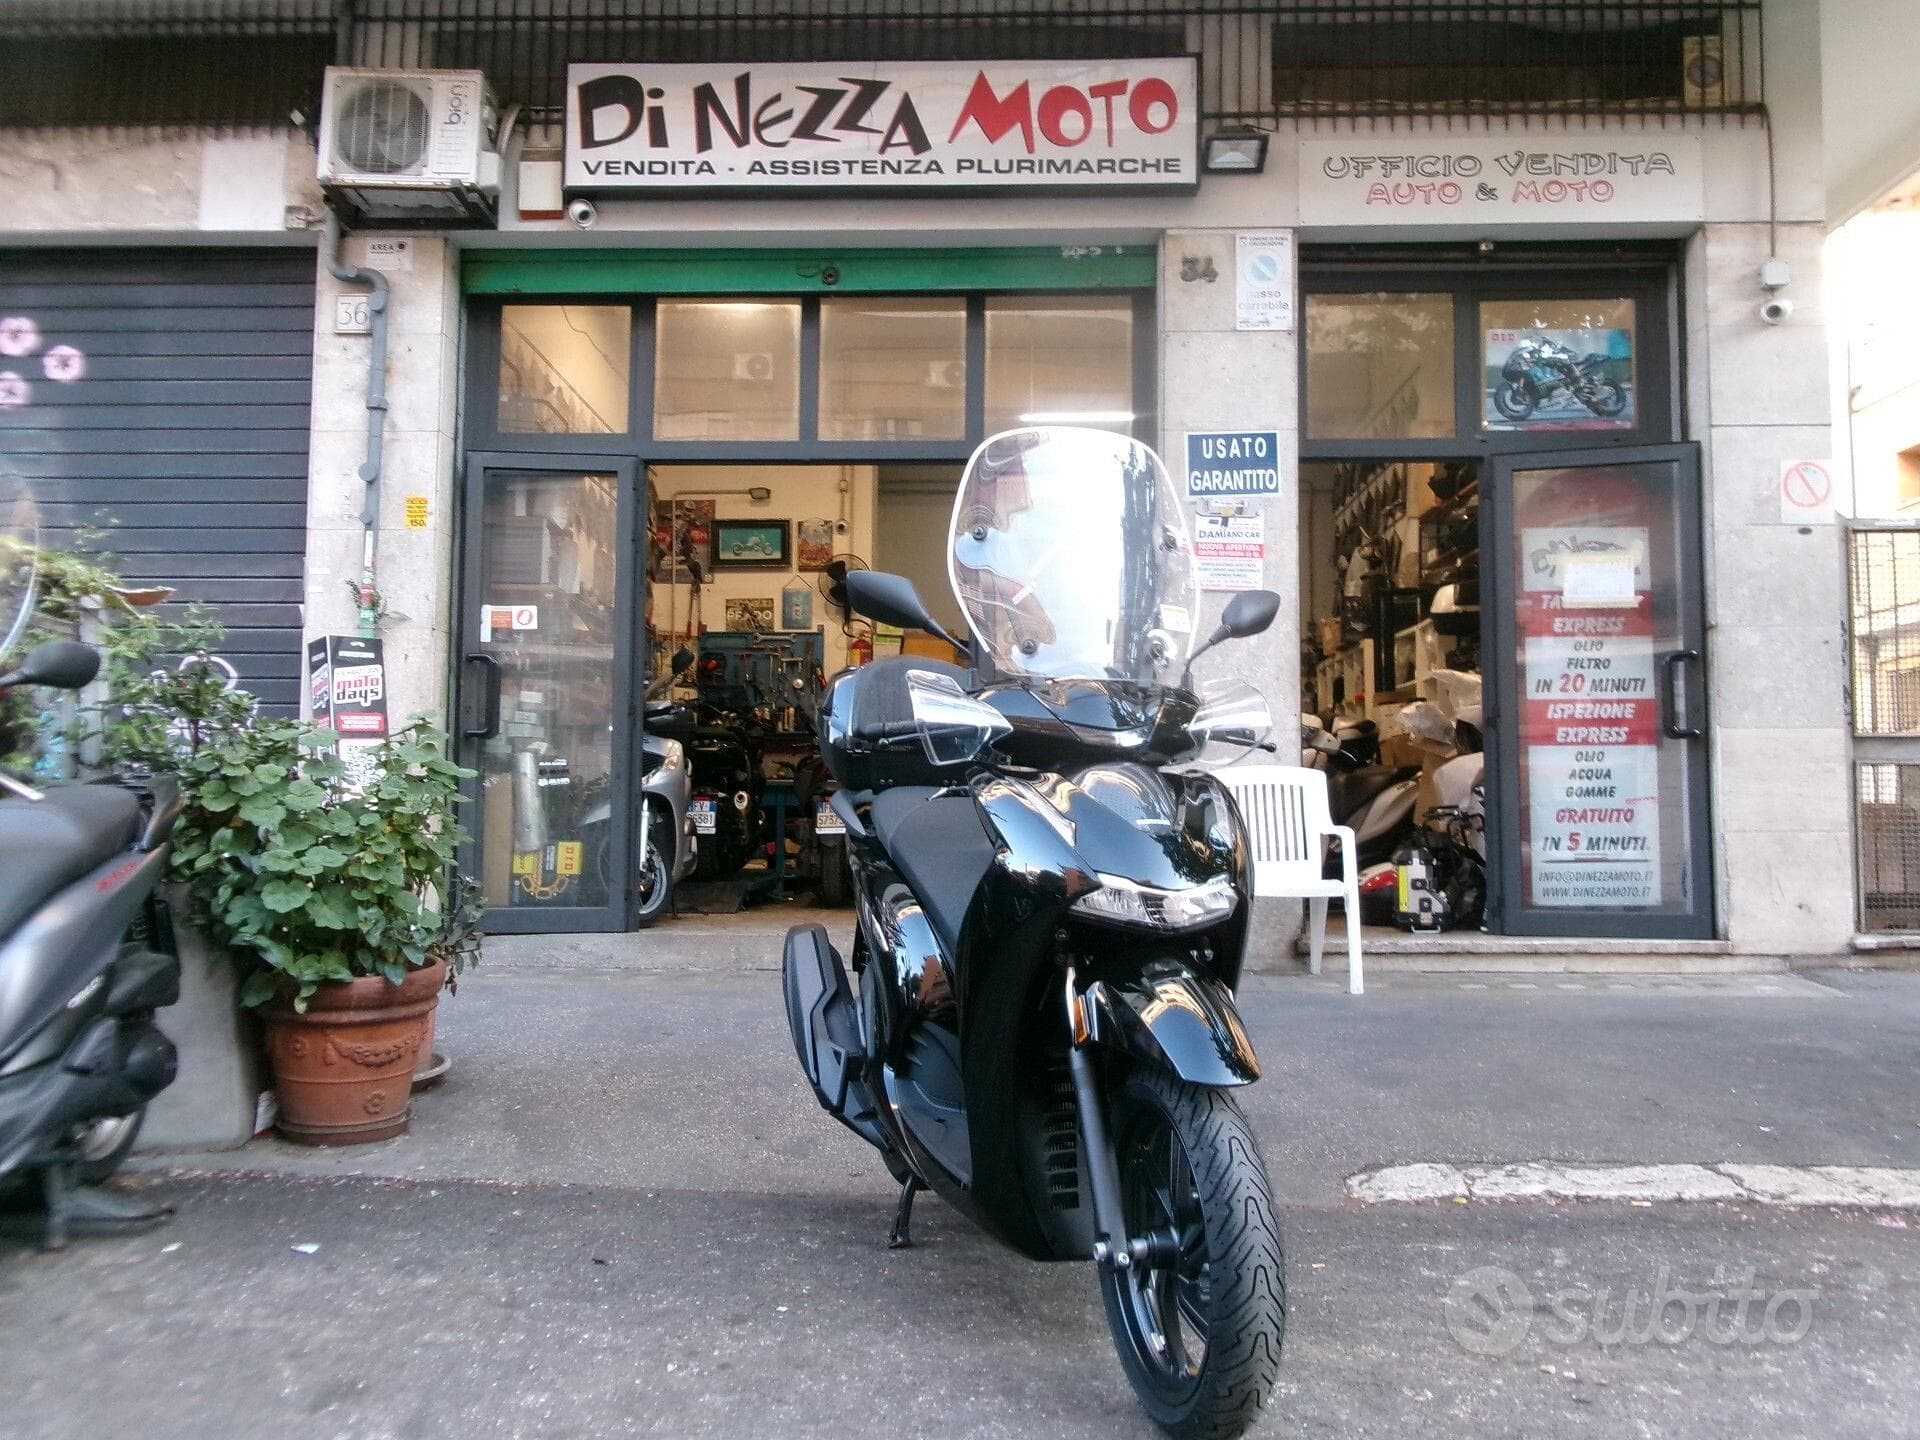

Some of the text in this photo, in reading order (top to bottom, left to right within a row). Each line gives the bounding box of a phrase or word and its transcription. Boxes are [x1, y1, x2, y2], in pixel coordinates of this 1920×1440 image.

[578, 73, 669, 149] Di
[948, 69, 1178, 155] MOTO
[582, 159, 715, 175] VENDITA
[747, 158, 944, 175] ASSISTENZA
[956, 157, 1182, 174] PLURIMARCHE
[1323, 150, 1675, 178] UFFICIO VENDITA
[1366, 179, 1614, 205] AUTO & MOTO
[338, 301, 369, 325] 36
[1202, 437, 1267, 459] USATO
[1190, 468, 1277, 492] GARANTITO
[1566, 658, 1611, 669] FILTRO
[1535, 673, 1646, 693] IN 20 MINUTI
[336, 687, 379, 703] days
[1547, 703, 1636, 719] ISPEZIONE
[1556, 726, 1629, 743] EXPRESS
[1575, 751, 1605, 762] OLIO
[1569, 768, 1611, 780] ACQUA
[1566, 786, 1616, 798] GOMME
[1556, 808, 1635, 824] GRATUITO
[1542, 836, 1561, 851] IN
[1567, 832, 1581, 851] 5
[1538, 870, 1653, 883] INFO@DINEZZAMOTO.IT
[1542, 886, 1651, 898] WWW.DINEZZAMOTO.IT
